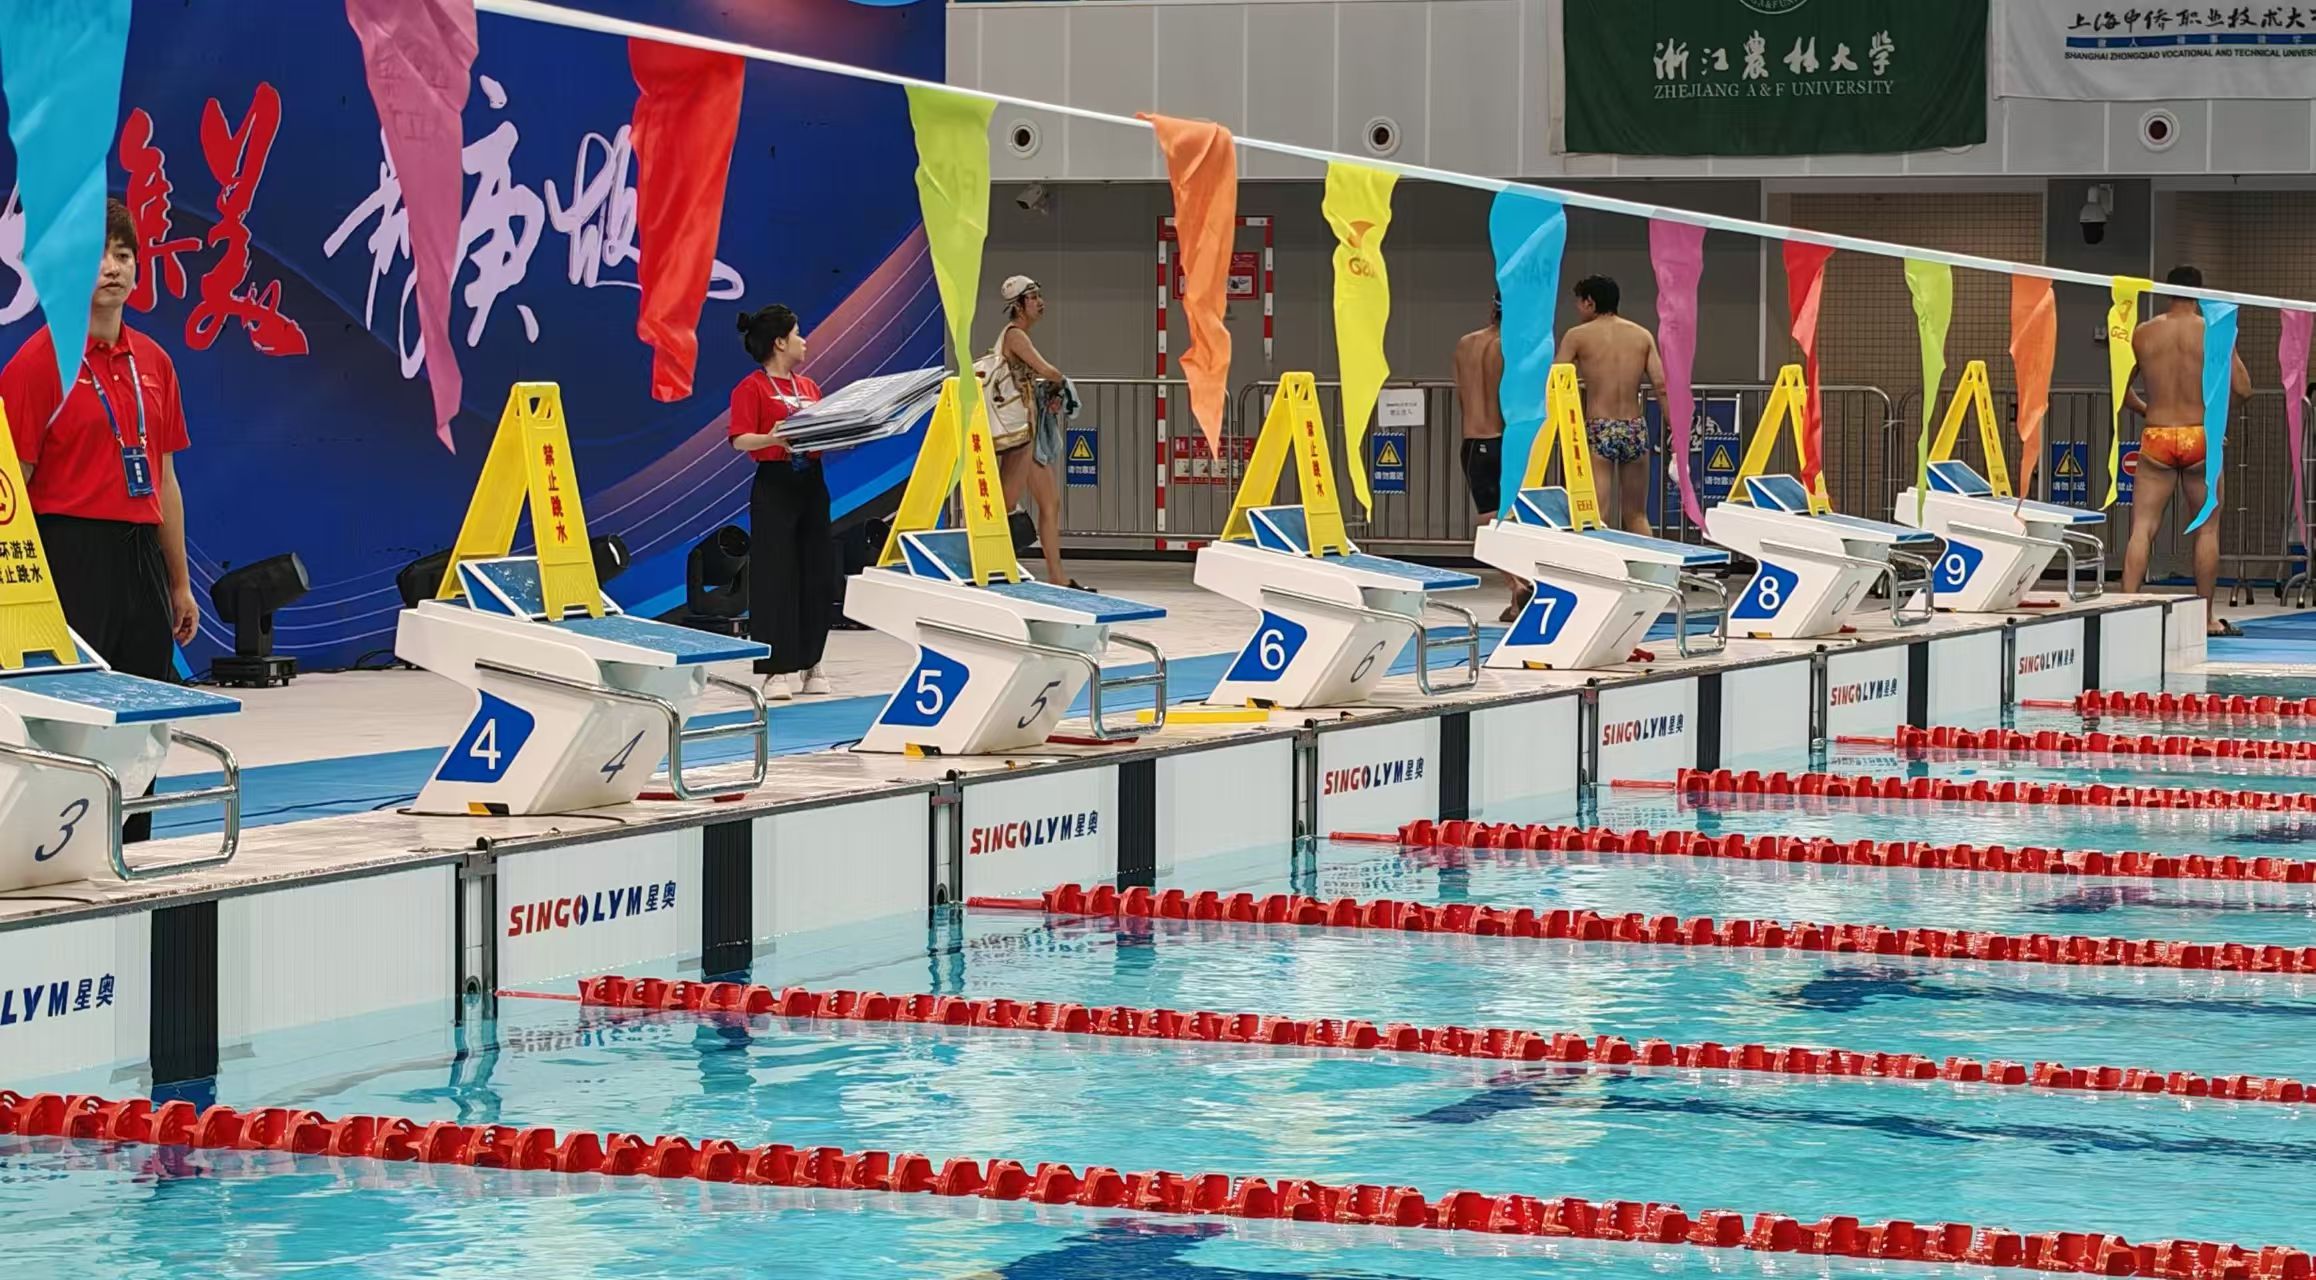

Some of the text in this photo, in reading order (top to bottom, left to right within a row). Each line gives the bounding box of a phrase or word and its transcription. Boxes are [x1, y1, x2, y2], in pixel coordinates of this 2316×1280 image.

[2064, 51, 2109, 61] SHANGHAI
[2110, 51, 2160, 61] ZHONGQIAO
[2162, 49, 2213, 59] VOCATIONAL
[2214, 49, 2233, 58] AND
[2234, 48, 2282, 58] TECHNICAL
[1653, 83, 1740, 99] ZHEJIANG
[1791, 80, 1895, 97] UNIVERSITY
[970, 432, 994, 521] 禁止跳水
[1305, 419, 1325, 497] 禁止跳水
[542, 443, 568, 544] 禁止跳水
[0, 563, 43, 584] 止跳水
[1945, 553, 1966, 586] 9
[1757, 575, 1781, 611] 8
[1831, 580, 1861, 616] 8
[1533, 597, 1558, 636] 7
[1610, 610, 1646, 650] 7
[1259, 628, 1286, 671] 6
[1350, 640, 1386, 684] 6
[915, 668, 944, 716] 5
[1016, 680, 1062, 730] 5
[470, 717, 502, 770] 4
[599, 729, 646, 784] 4
[34, 797, 89, 862] 3
